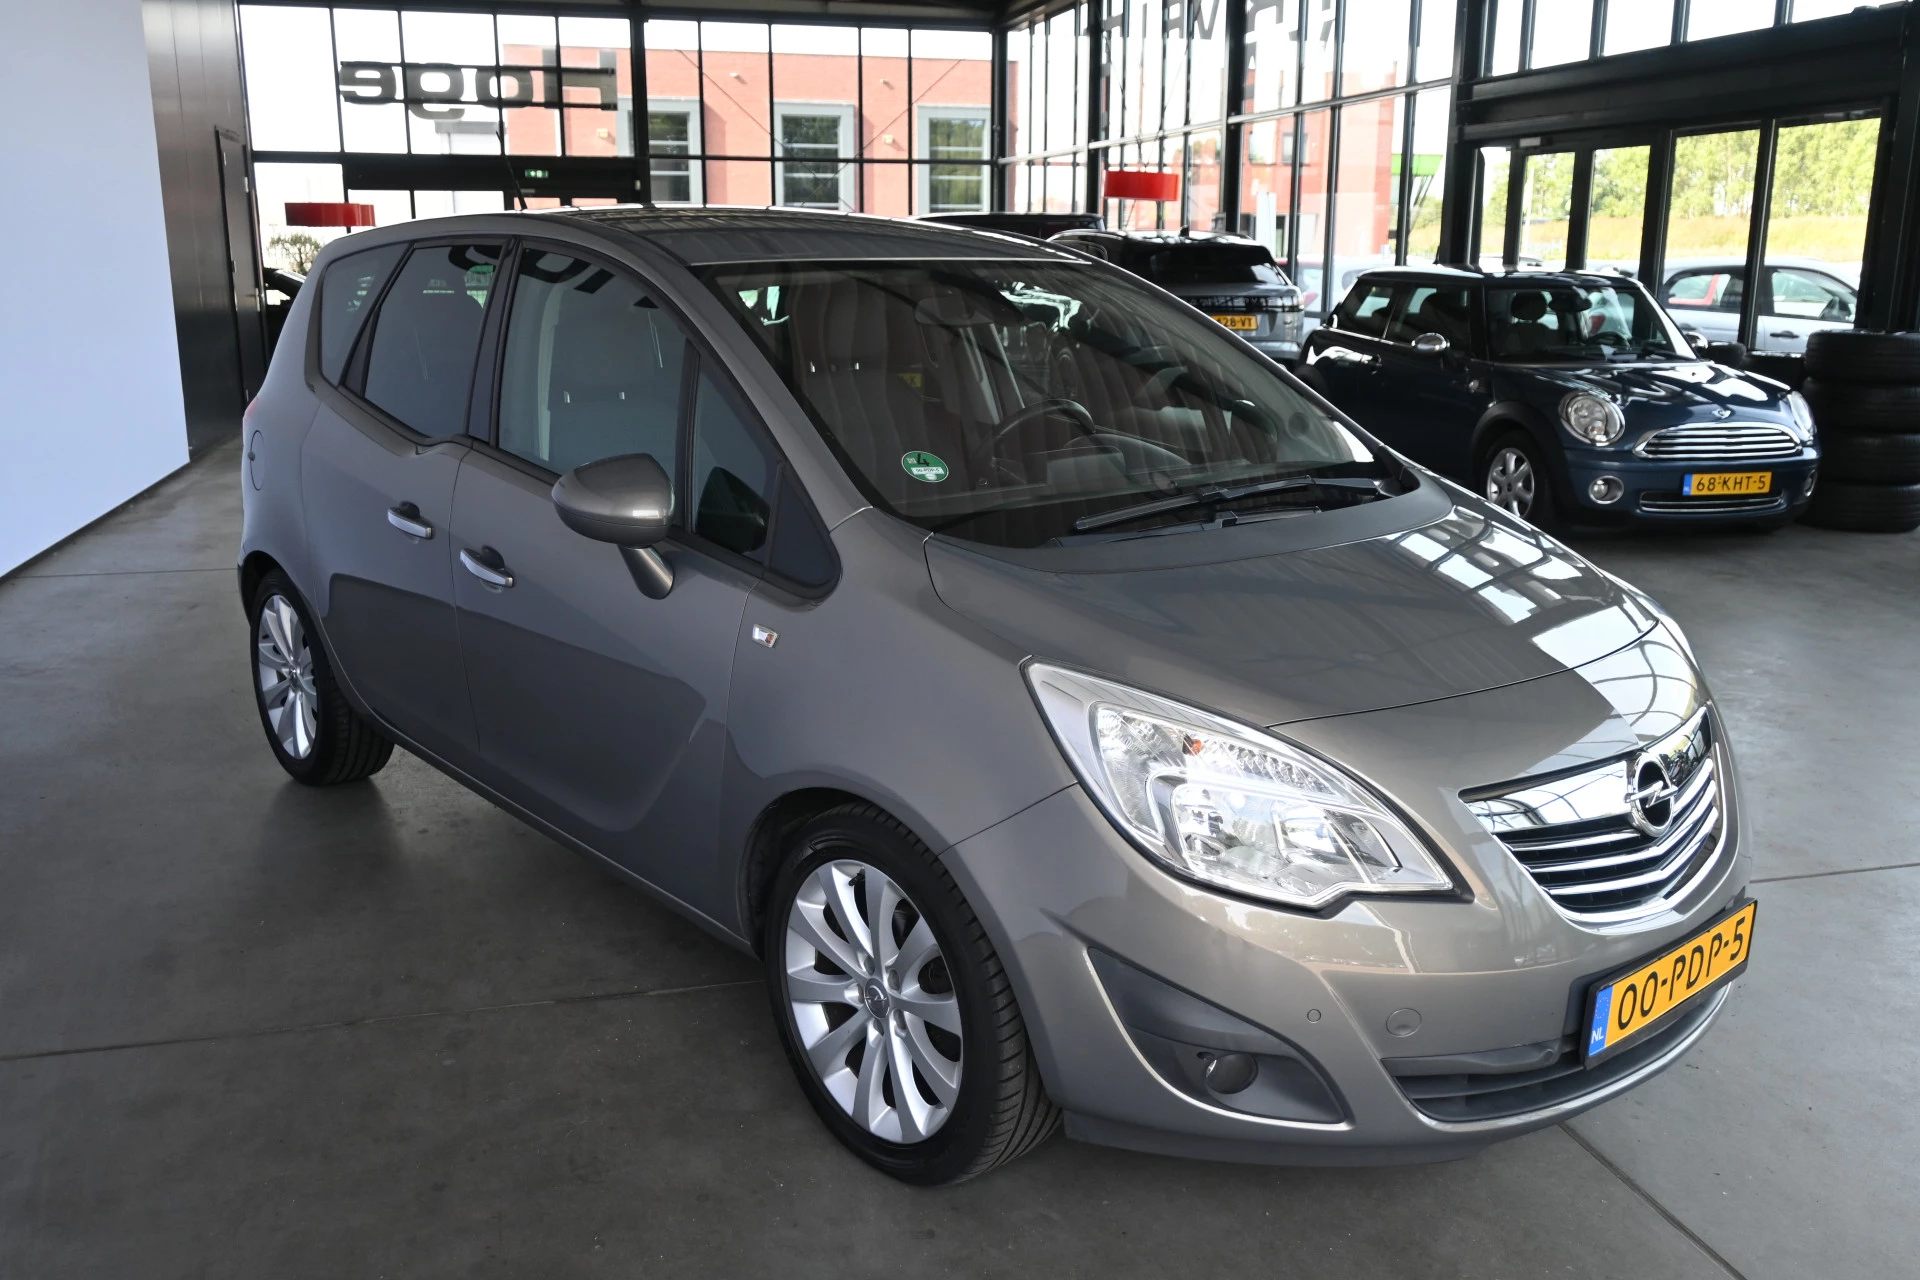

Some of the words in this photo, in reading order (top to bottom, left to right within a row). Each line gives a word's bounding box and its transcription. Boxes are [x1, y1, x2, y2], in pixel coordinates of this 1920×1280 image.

[917, 453, 930, 467] 4
[1696, 475, 1767, 492] 68-KHT-5
[1617, 915, 1746, 1031] 00-PDP-5
[1591, 1026, 1605, 1044] NL
